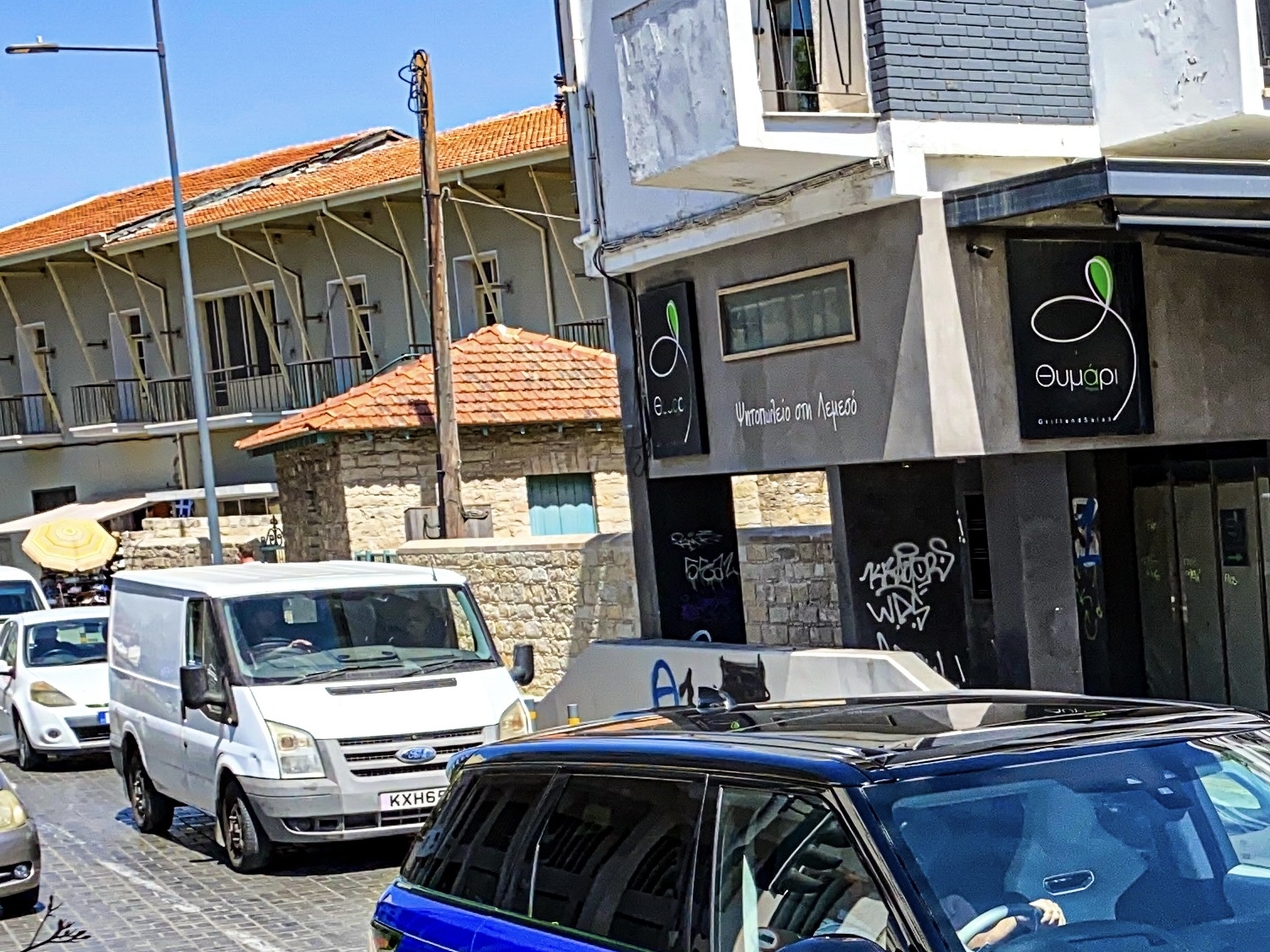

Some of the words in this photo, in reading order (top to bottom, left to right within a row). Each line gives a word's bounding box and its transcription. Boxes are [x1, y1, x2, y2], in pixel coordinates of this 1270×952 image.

[1035, 363, 1119, 391] Θυμάρι
[795, 402, 813, 421] στη
[817, 389, 858, 432] Λεμεσό
